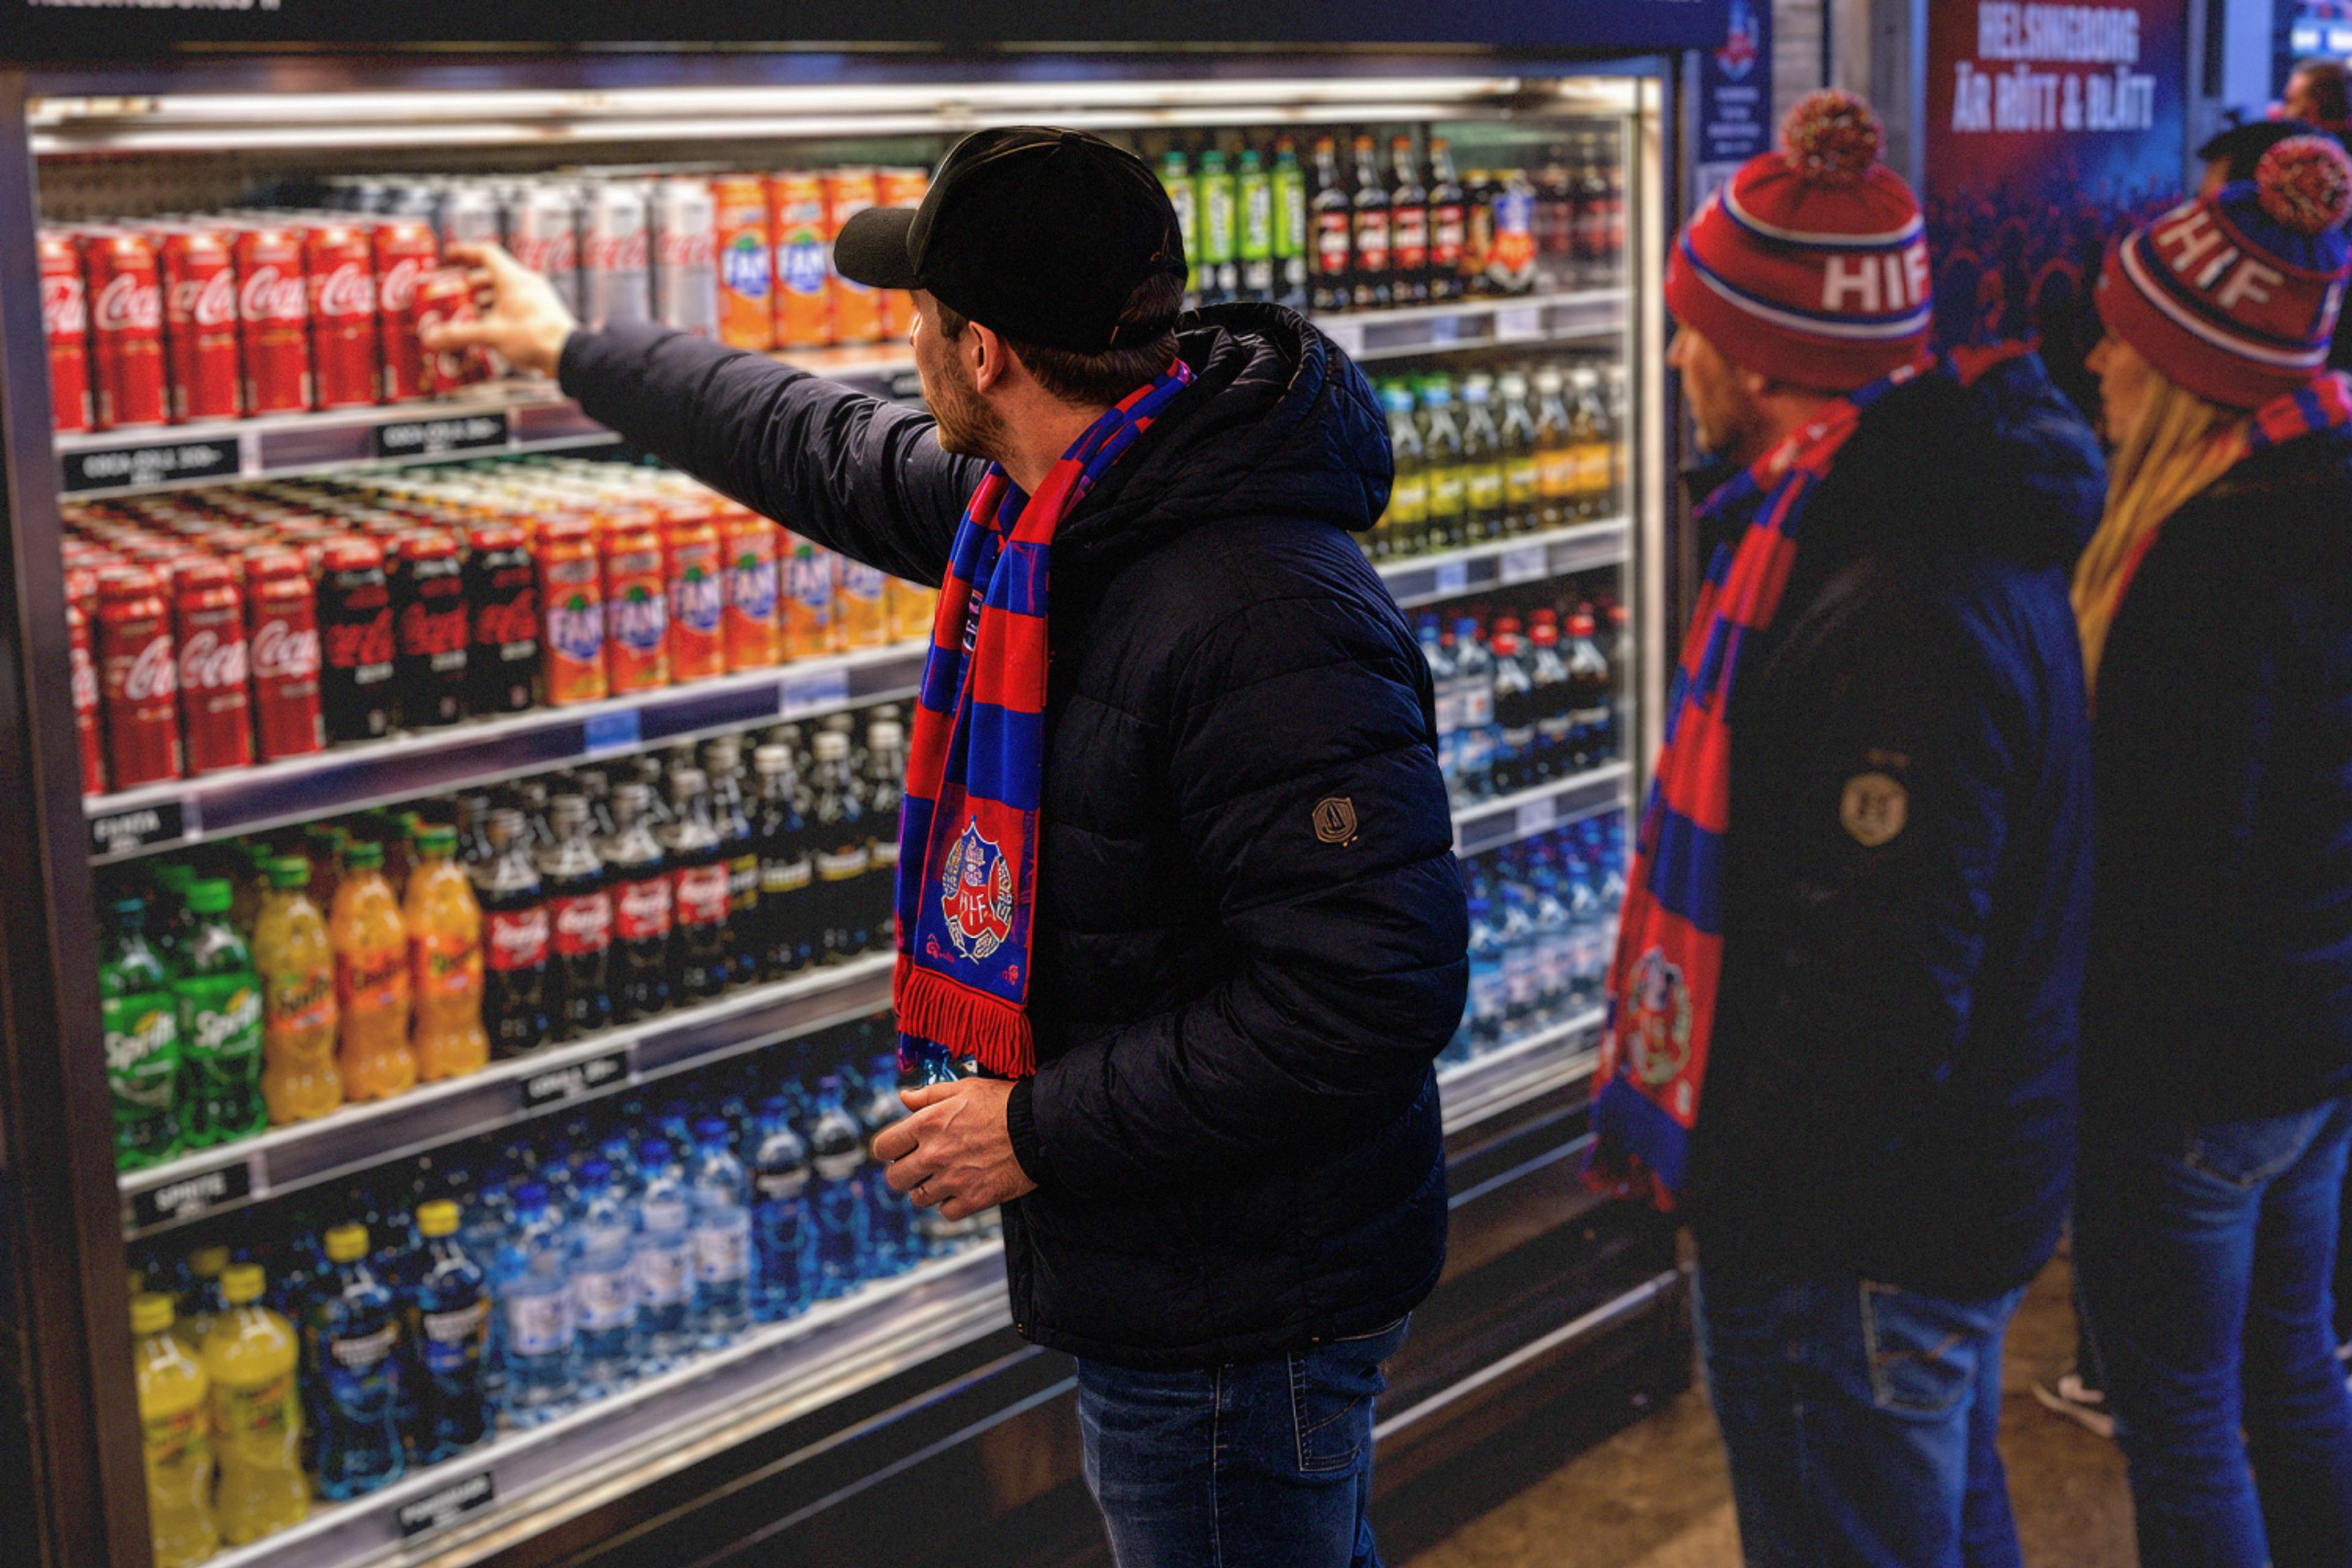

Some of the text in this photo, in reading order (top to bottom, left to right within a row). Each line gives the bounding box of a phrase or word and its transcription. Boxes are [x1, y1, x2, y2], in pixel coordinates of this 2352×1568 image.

[1978, 2, 2139, 62] HELSINGBORG
[1822, 243, 1929, 312] HIF
[2157, 211, 2283, 307] HIF
